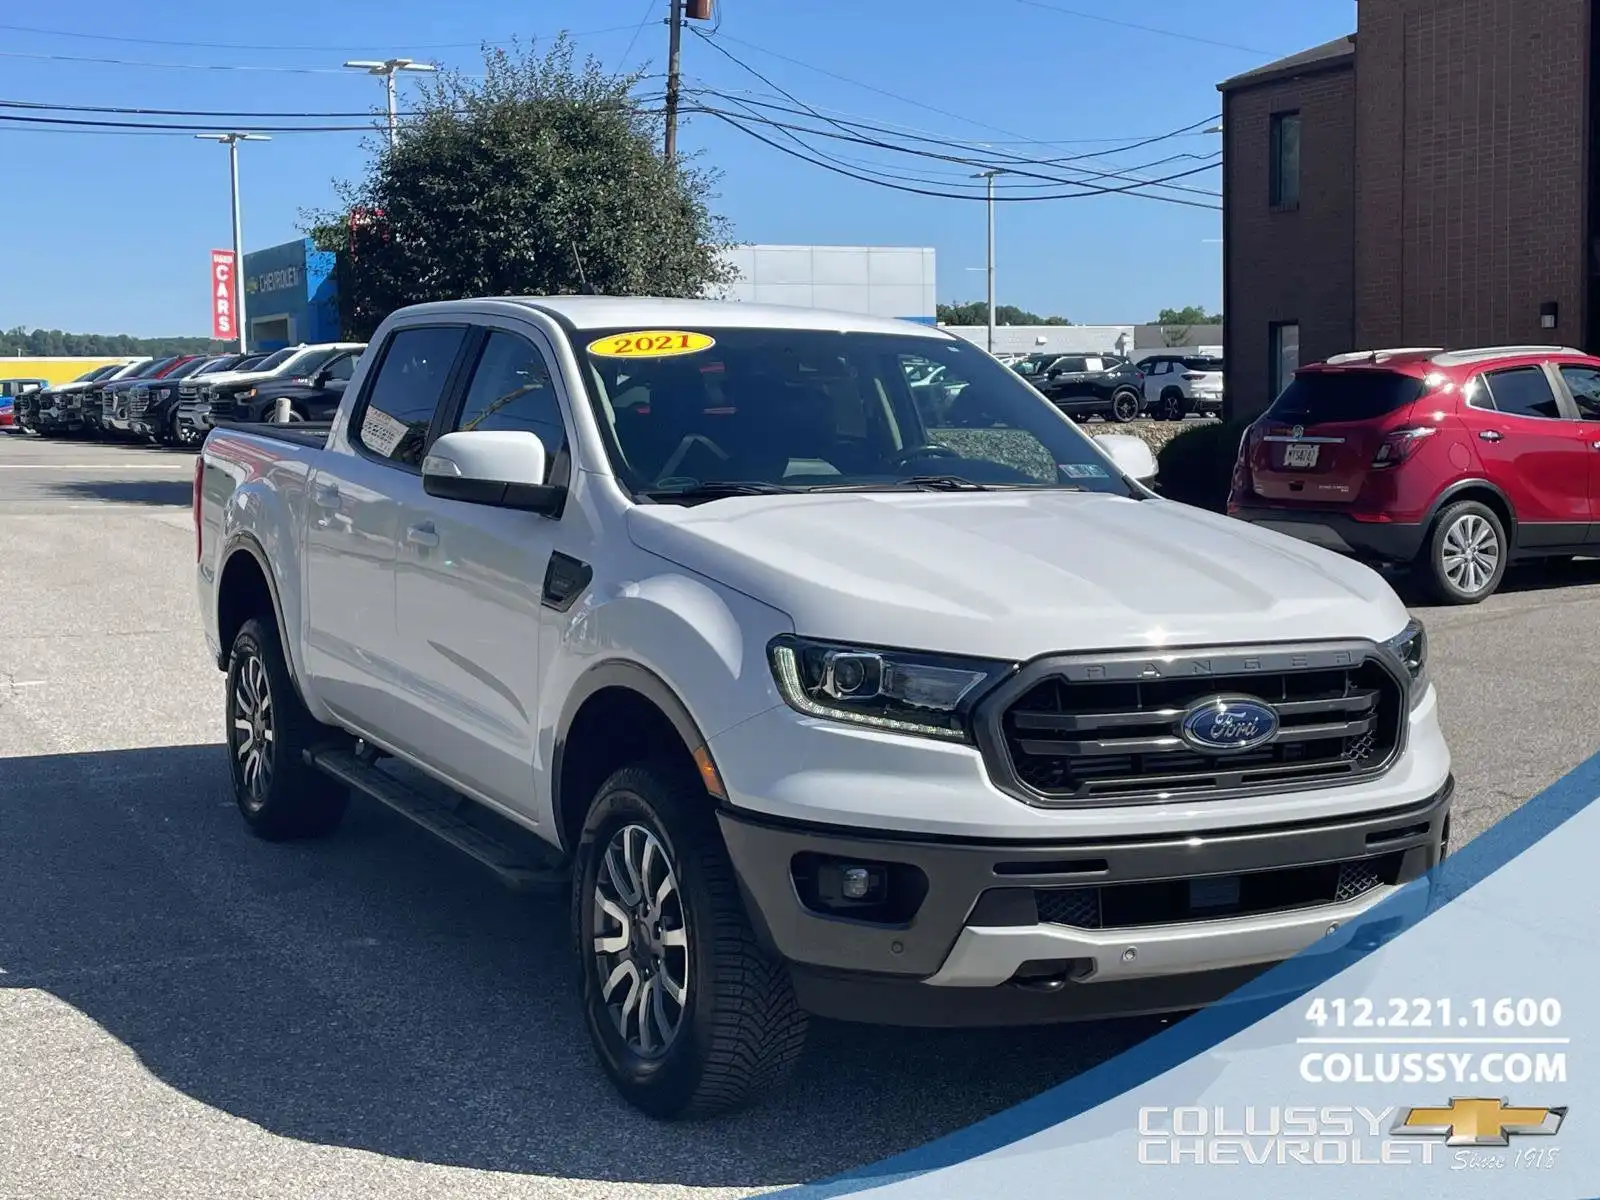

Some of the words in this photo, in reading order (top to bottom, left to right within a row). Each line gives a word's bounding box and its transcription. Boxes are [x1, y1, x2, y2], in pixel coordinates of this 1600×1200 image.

[215, 264, 231, 333] CARS
[614, 334, 690, 354] 2021
[1087, 652, 1351, 679] RANGER
[1210, 712, 1259, 739] Ford
